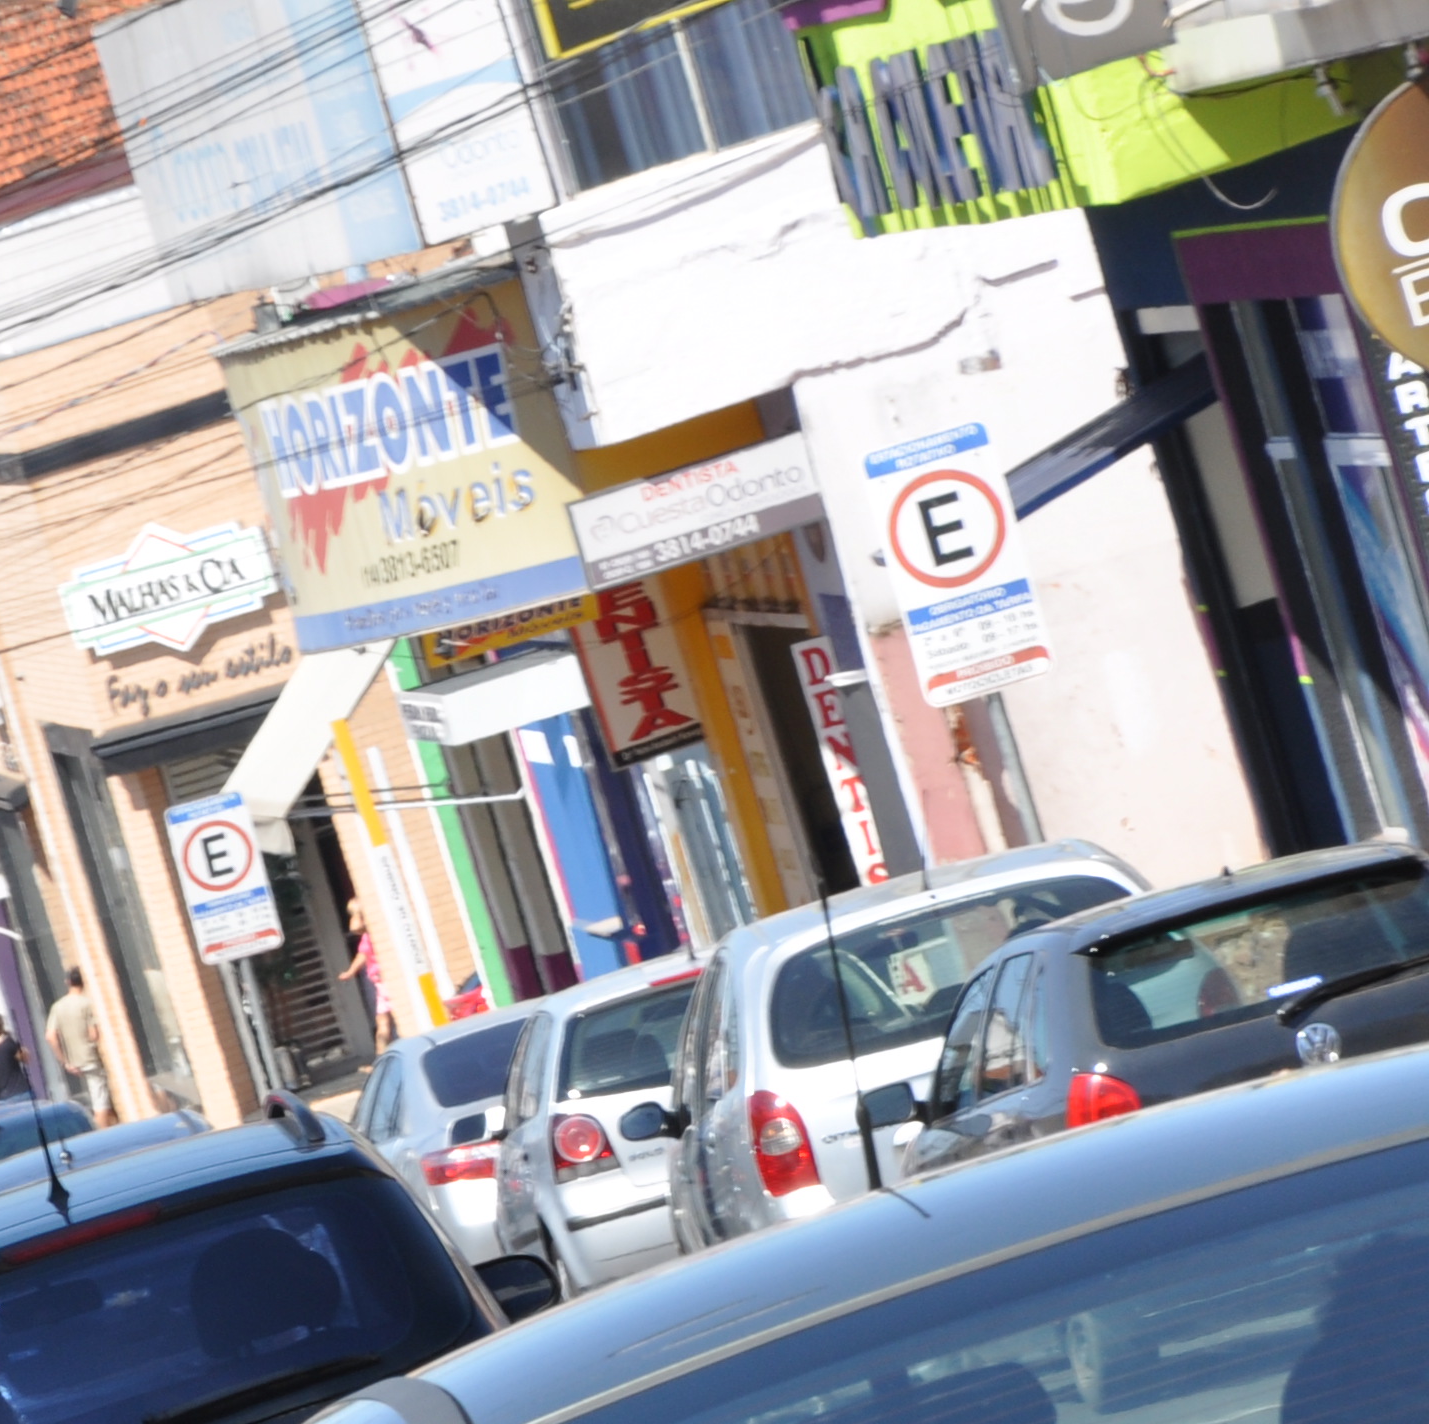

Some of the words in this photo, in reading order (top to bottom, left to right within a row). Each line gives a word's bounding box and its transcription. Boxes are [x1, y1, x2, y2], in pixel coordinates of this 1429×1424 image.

[259, 341, 521, 498] HORIZONTE
[378, 461, 535, 543] Móveis
[640, 460, 739, 502] DENTISTA
[653, 513, 761, 563] 3814-0744
[916, 491, 975, 567] E
[88, 574, 181, 623] MALHAS
[202, 833, 234, 878] E
